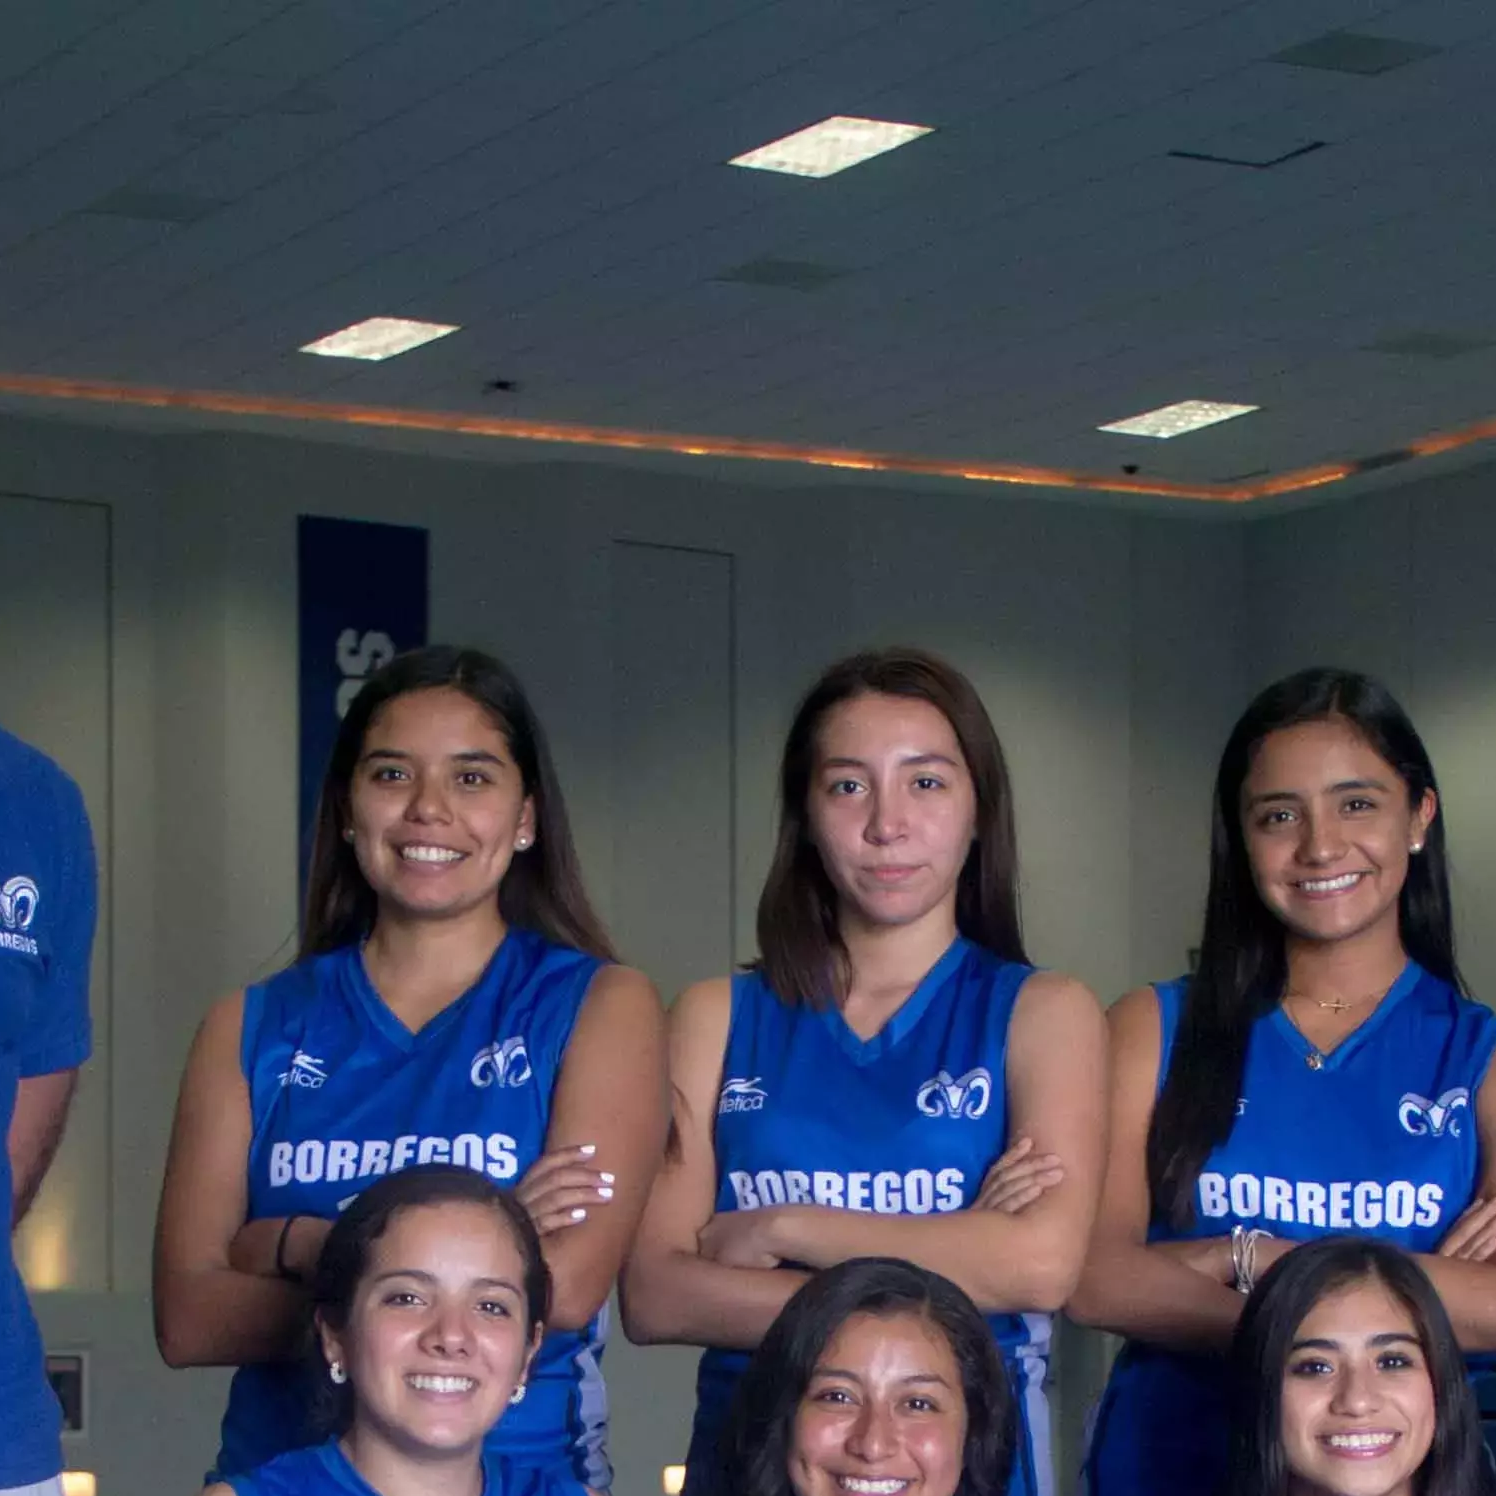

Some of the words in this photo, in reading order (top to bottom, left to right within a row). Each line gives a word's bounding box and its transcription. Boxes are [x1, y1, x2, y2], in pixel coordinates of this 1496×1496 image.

[269, 1133, 518, 1188] BORREGOS
[729, 1168, 965, 1215] BORREGOS
[1199, 1171, 1444, 1229] BORREGOS
